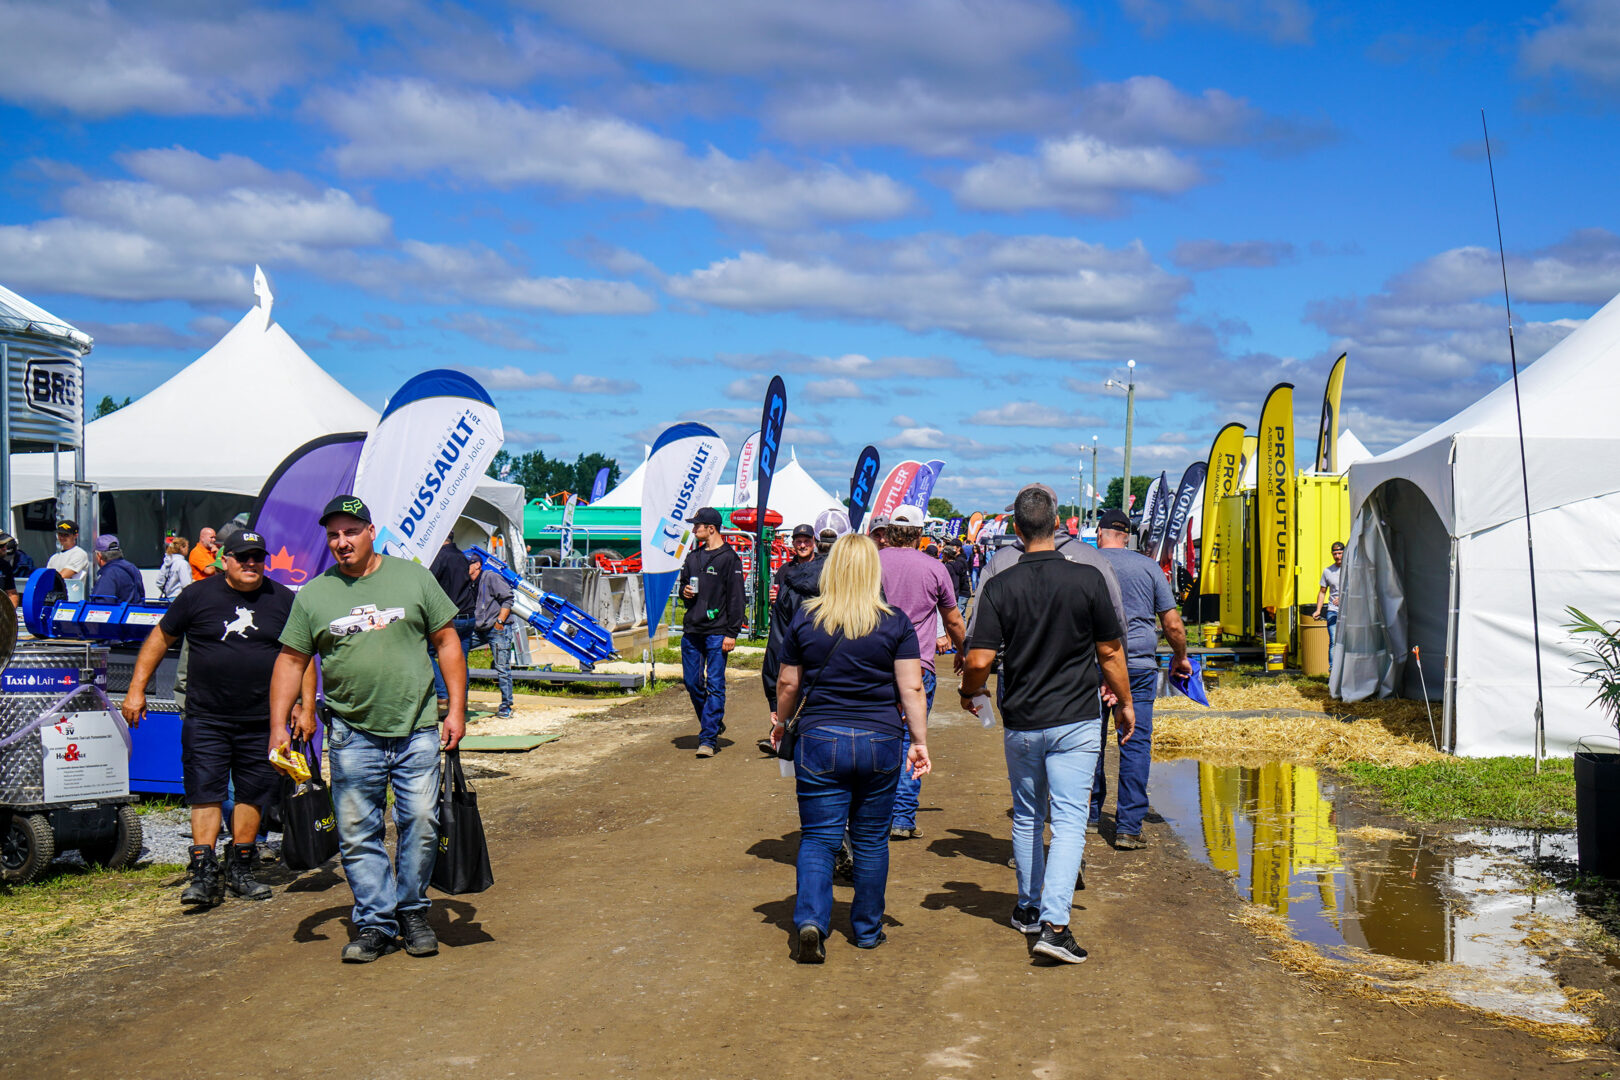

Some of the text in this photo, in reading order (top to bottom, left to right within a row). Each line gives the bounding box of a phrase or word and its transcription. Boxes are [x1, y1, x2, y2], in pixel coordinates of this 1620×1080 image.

[760, 393, 784, 478] PF3
[1266, 426, 1274, 496] ASSURANCE
[399, 415, 475, 539] DUSSAULT
[416, 437, 486, 549] Membre du Groupe Jolco
[670, 446, 710, 521] DUSSAULT
[852, 456, 877, 508] PF3
[1169, 483, 1195, 540] FUSION
[1274, 426, 1287, 577] PROMUTUEL
[243, 533, 259, 541] CAT
